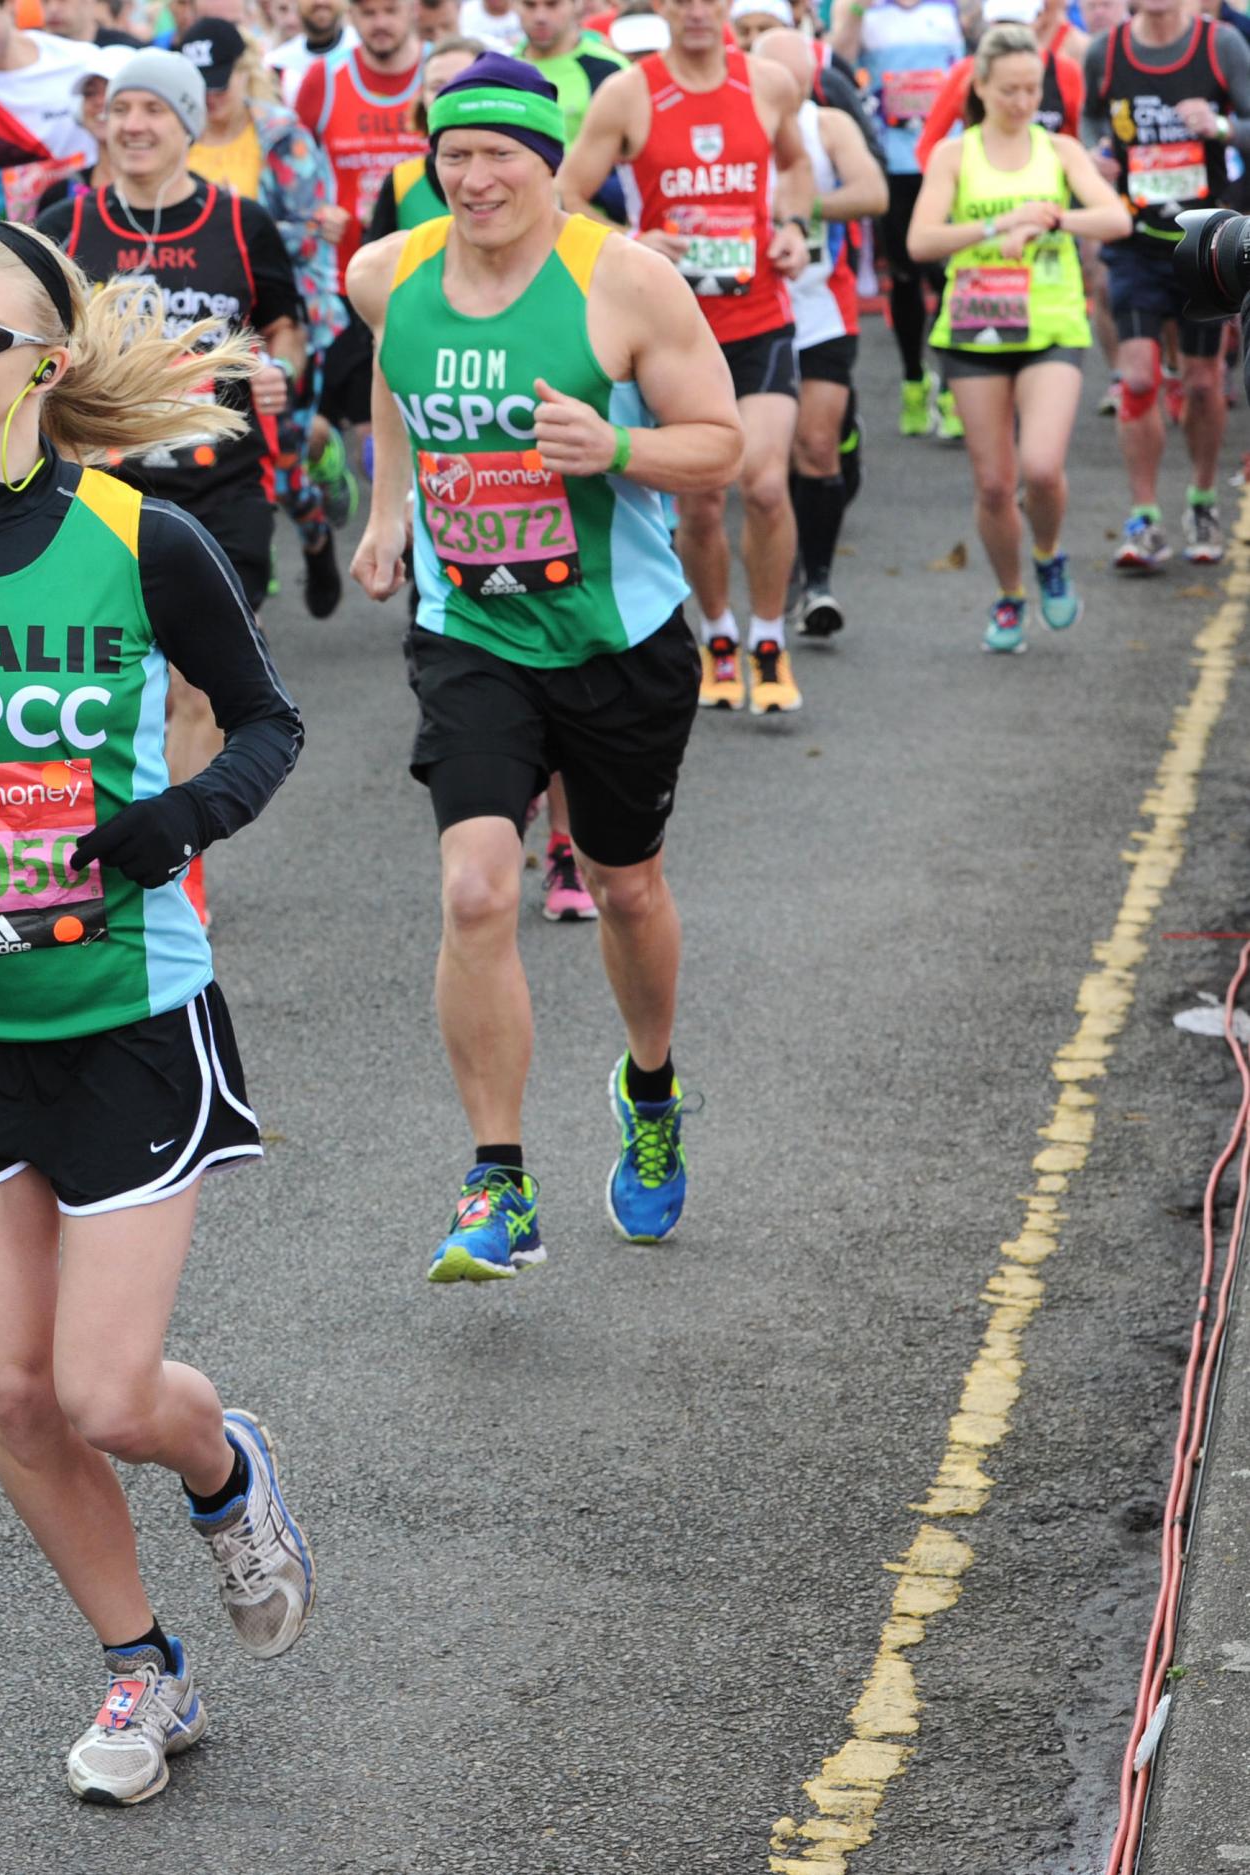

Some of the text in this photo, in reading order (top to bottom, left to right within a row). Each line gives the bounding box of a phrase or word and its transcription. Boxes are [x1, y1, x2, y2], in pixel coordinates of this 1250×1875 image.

[660, 162, 757, 198] GRAEME
[117, 248, 197, 271] MARK
[435, 348, 506, 389] DOM
[477, 470, 552, 487] money
[431, 505, 567, 553] 23972
[480, 582, 527, 596] adidas
